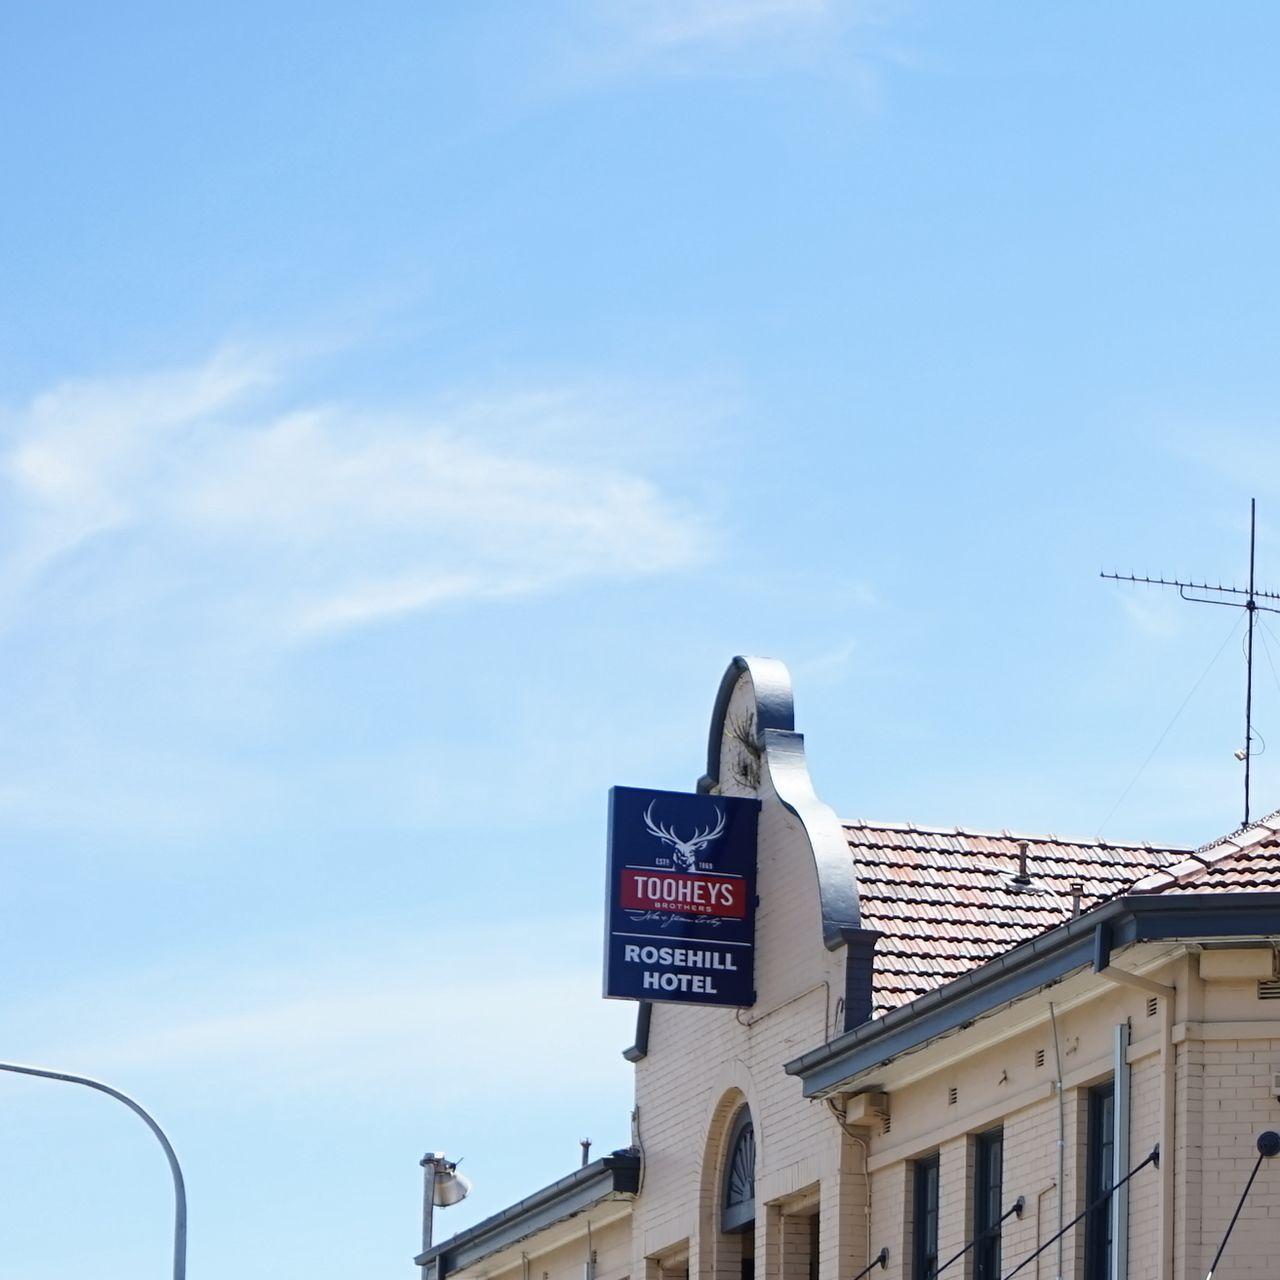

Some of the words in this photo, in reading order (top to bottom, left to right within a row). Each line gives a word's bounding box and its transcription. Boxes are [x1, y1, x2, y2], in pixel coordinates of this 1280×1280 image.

[633, 876, 733, 906] TOOHEYS
[654, 902, 712, 913] BROTHERS
[624, 944, 737, 971] ROSEHILL
[643, 971, 717, 994] HOTEL
